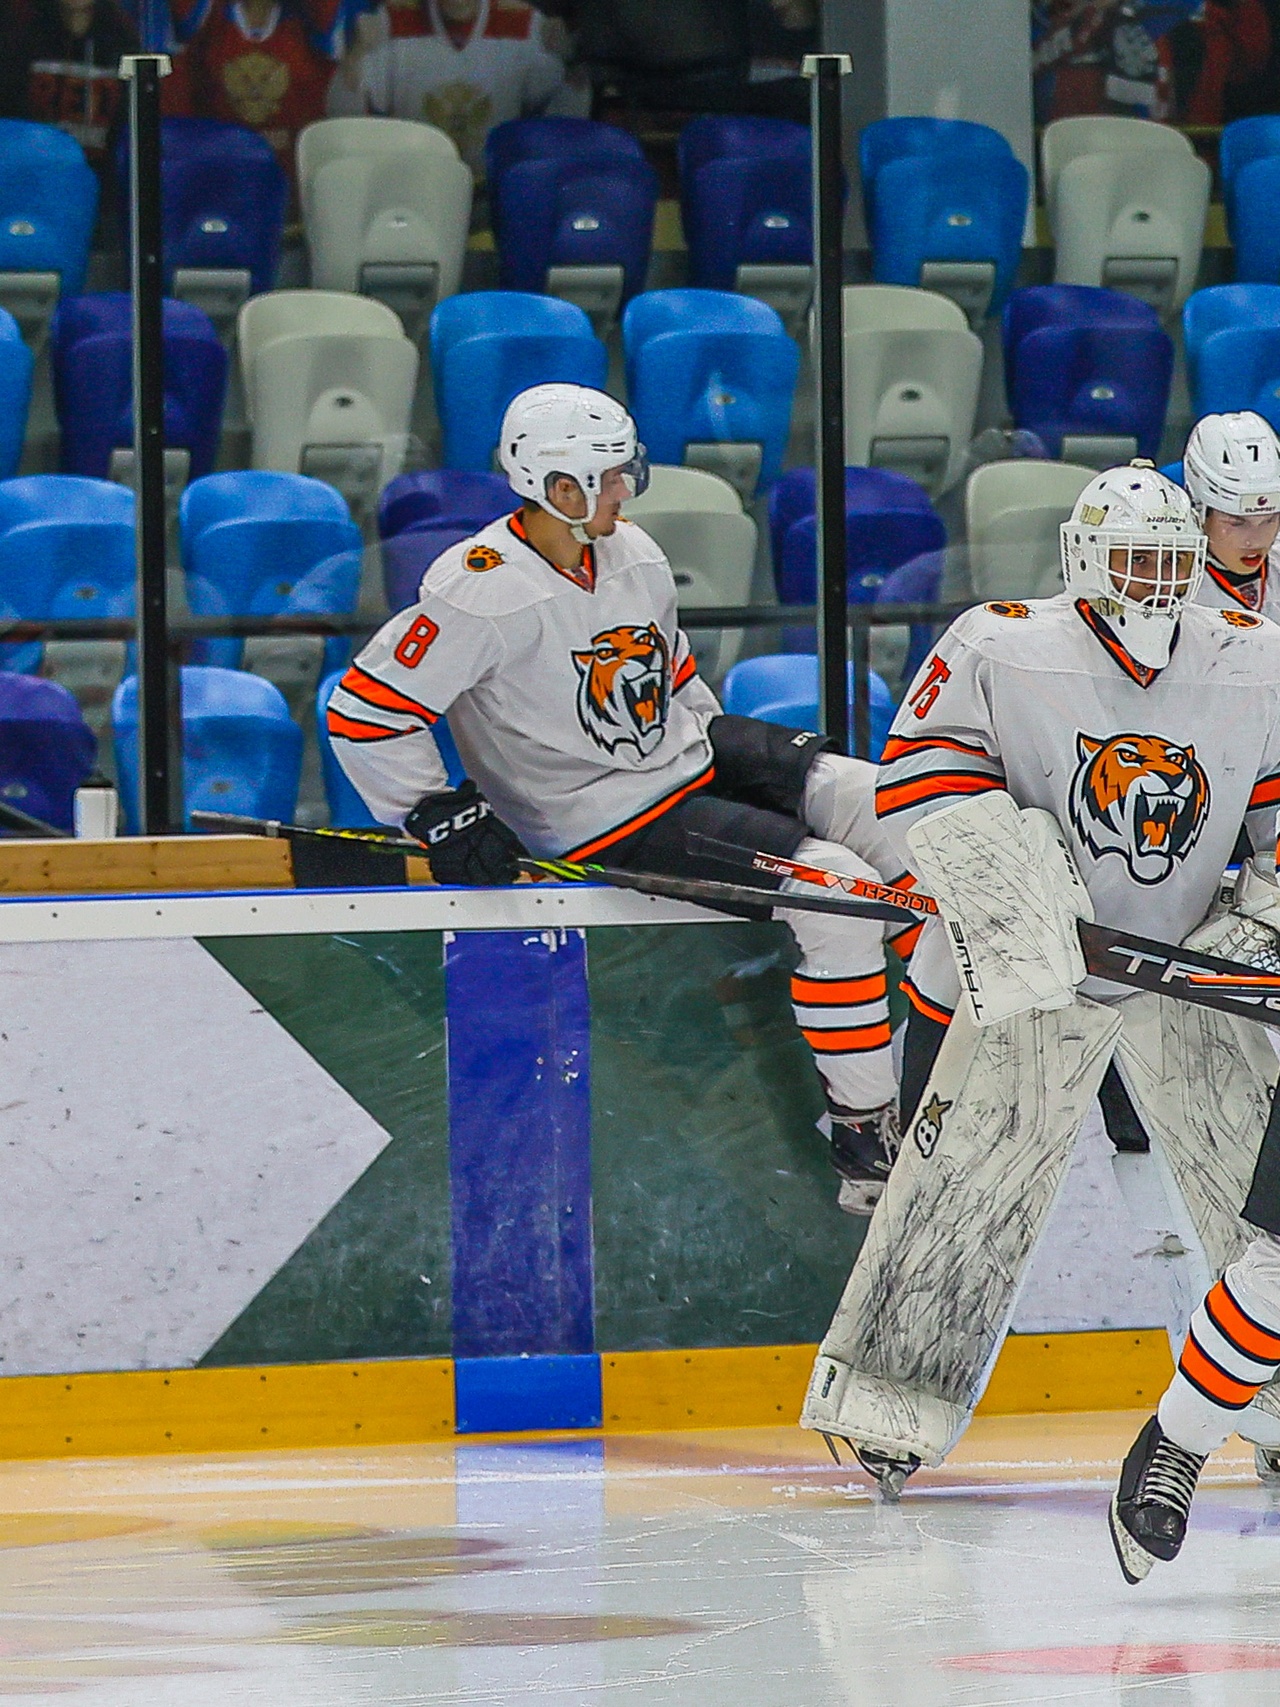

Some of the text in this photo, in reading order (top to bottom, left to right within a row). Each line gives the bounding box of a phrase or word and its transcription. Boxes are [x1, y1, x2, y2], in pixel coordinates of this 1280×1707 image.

[1245, 444, 1259, 462] 7
[393, 613, 441, 670] 8
[949, 921, 984, 1021] TRUE
